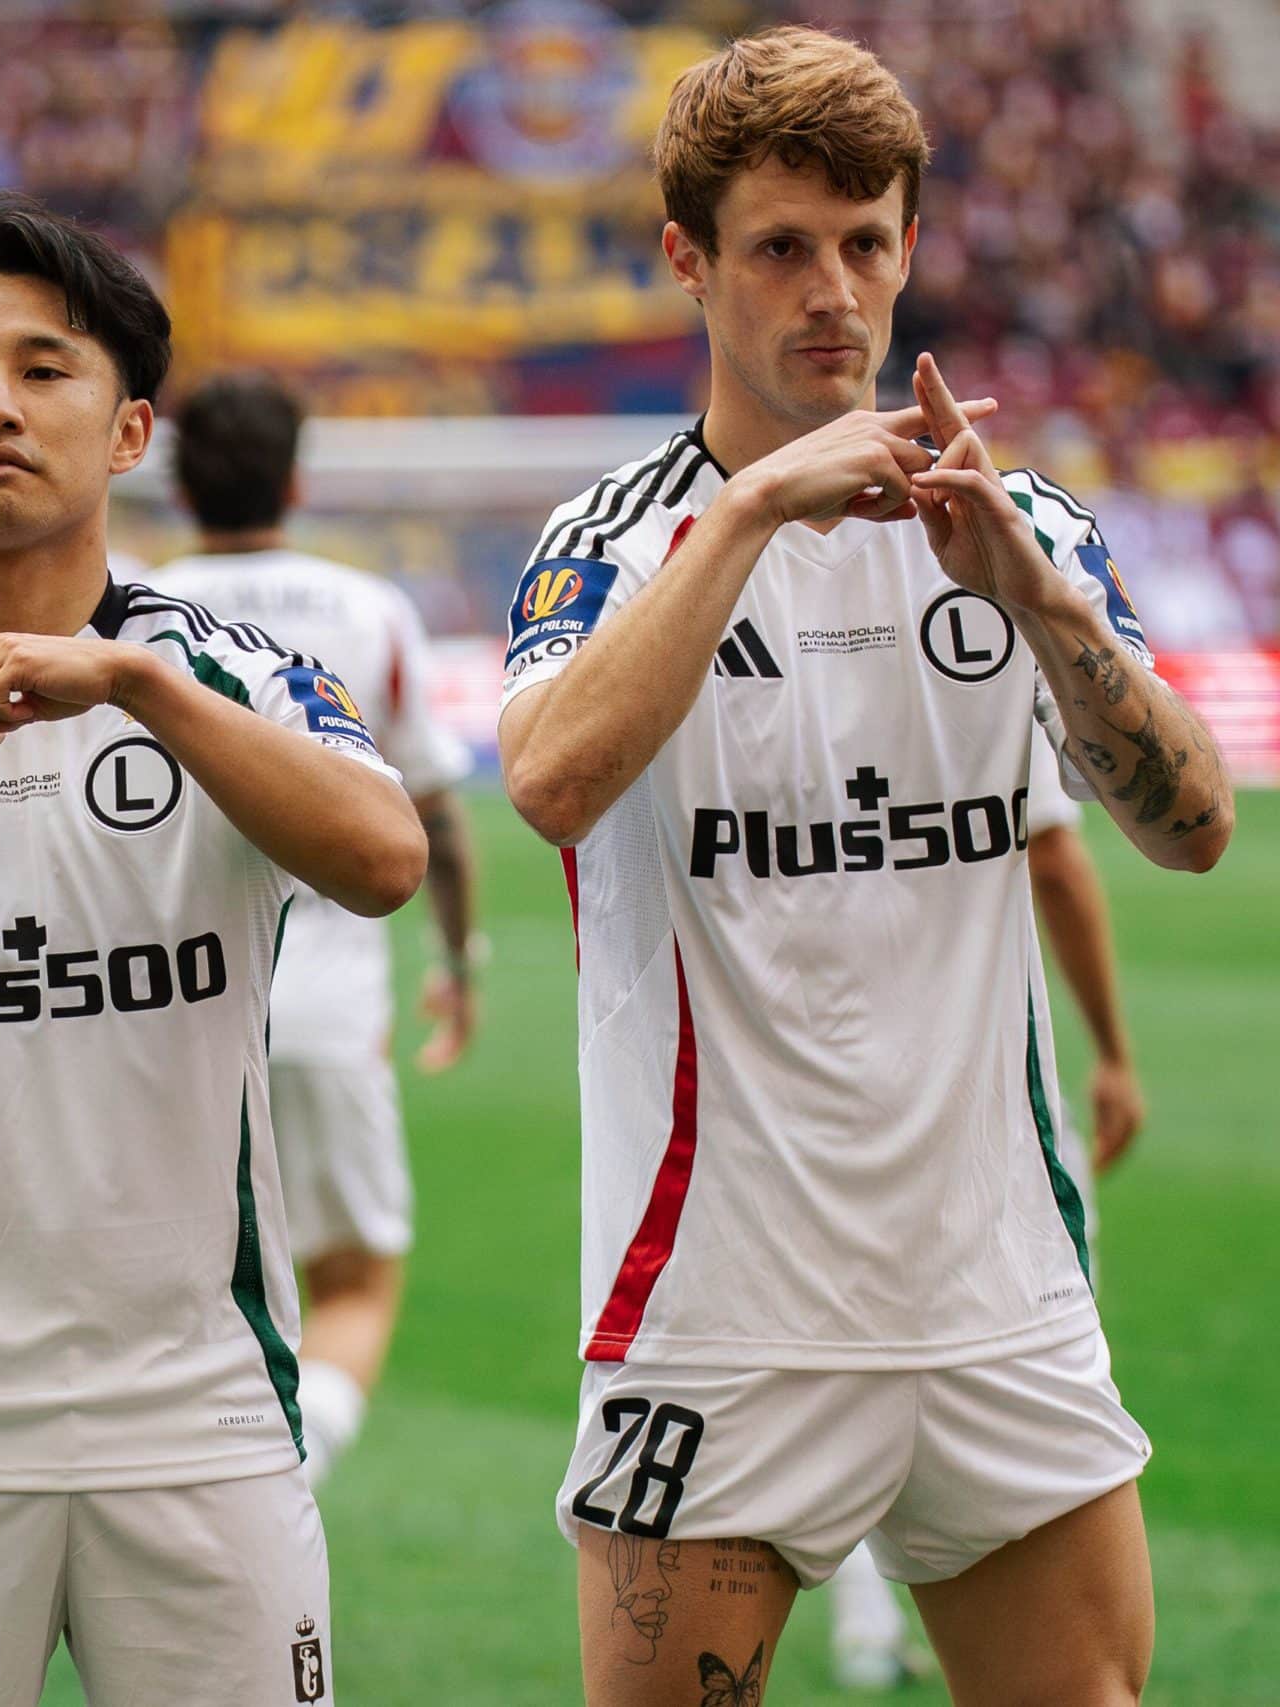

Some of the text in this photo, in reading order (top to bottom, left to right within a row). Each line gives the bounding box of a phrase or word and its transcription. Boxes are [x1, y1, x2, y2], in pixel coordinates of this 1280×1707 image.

[540, 619, 584, 633] POLSKI
[797, 625, 896, 640] PUCHAR POLSKI
[948, 607, 993, 664] L
[20, 771, 61, 786] POLSKI
[115, 756, 155, 812] L
[572, 1397, 705, 1539] 28
